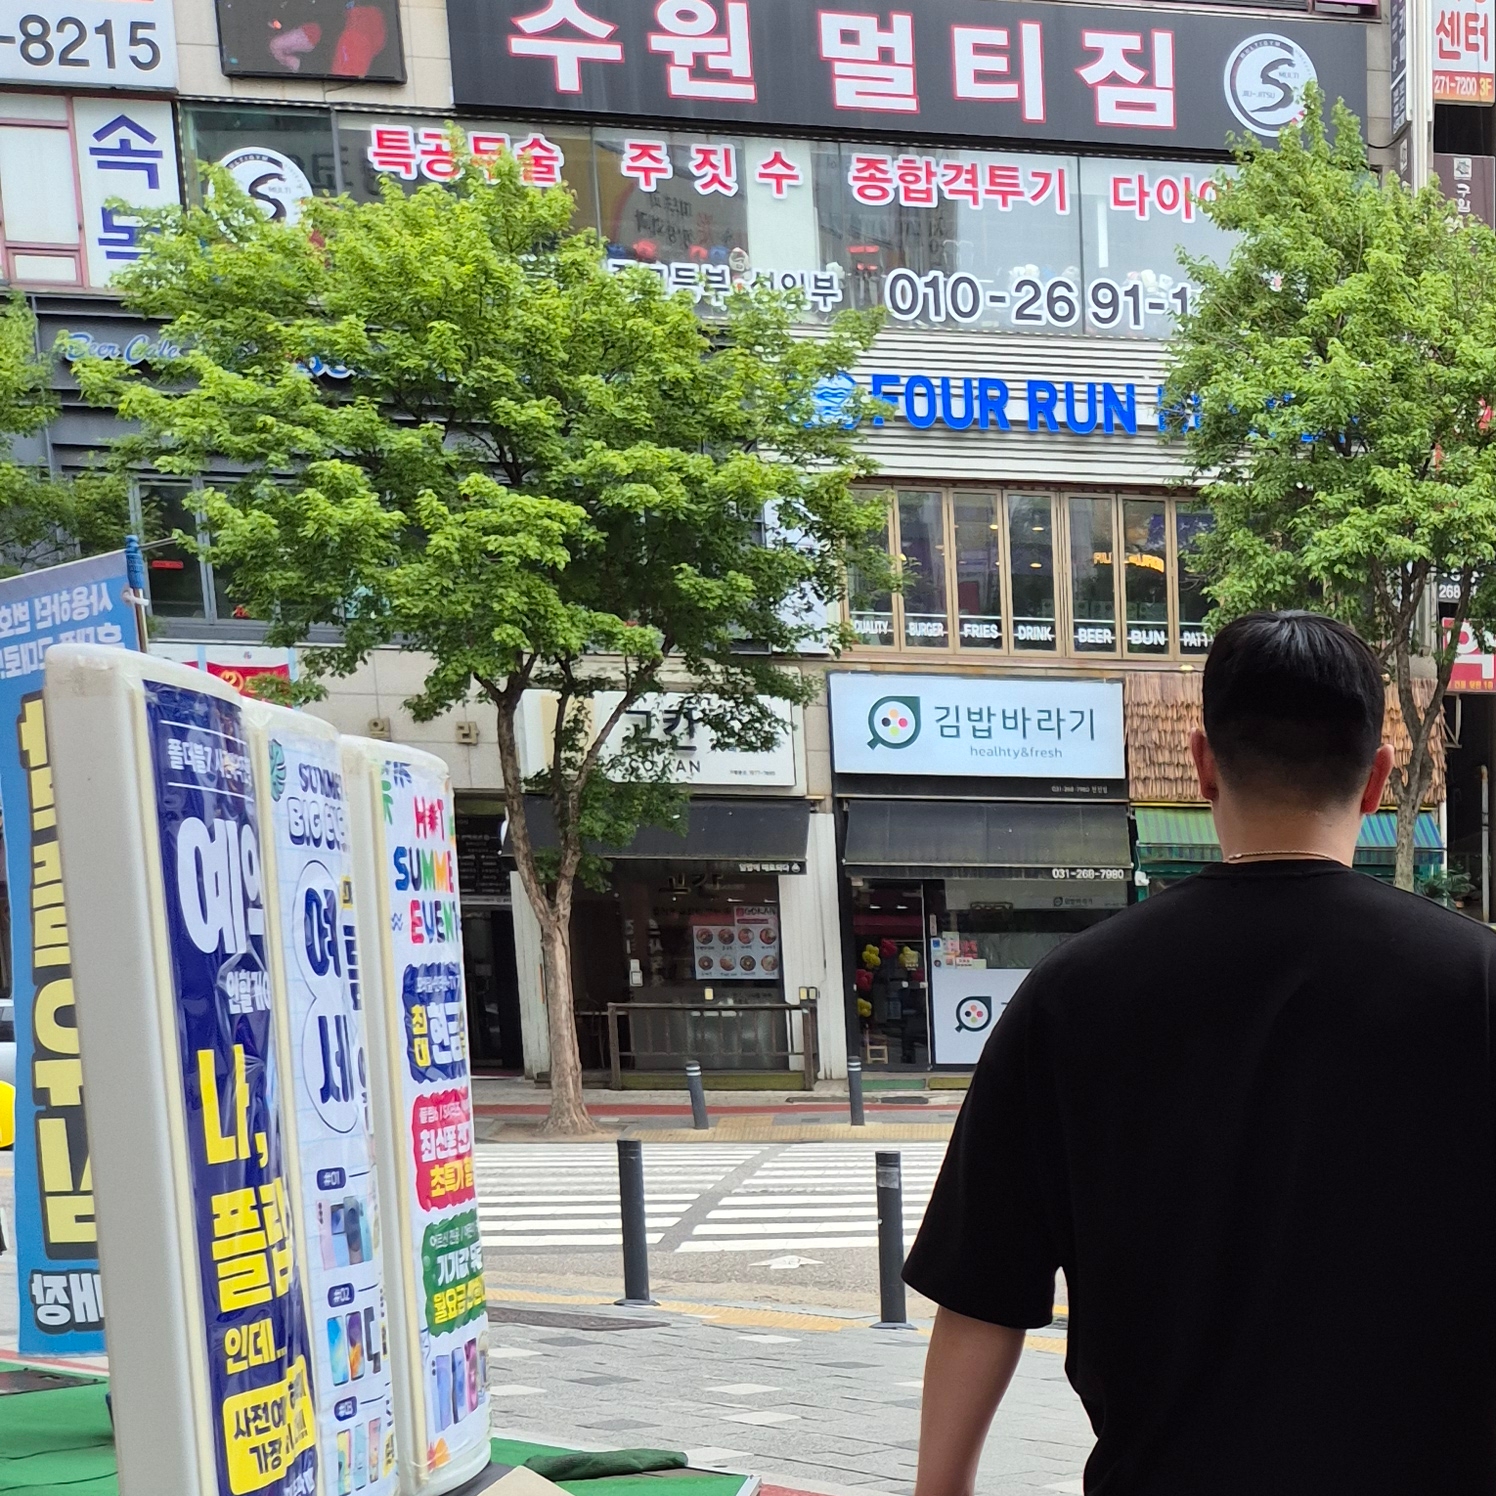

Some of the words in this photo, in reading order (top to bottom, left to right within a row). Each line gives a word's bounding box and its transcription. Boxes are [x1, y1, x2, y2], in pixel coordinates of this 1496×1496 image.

[1436, 10, 1489, 62] 센터
[508, 0, 757, 102] 수원
[818, 10, 1177, 129] 멀티짐
[1434, 75, 1477, 96] 271-7200
[1479, 77, 1493, 97] 3F
[848, 152, 1069, 215] 종합격투기
[1026, 380, 1138, 434] RUN
[908, 622, 945, 638] BURGER
[963, 623, 999, 640] FRIES
[1017, 625, 1052, 642] DRINK
[1078, 627, 1113, 644] BEER
[1130, 630, 1165, 646] BUN
[934, 705, 1095, 741] 김밥바라기
[322, 1170, 341, 1186] #01
